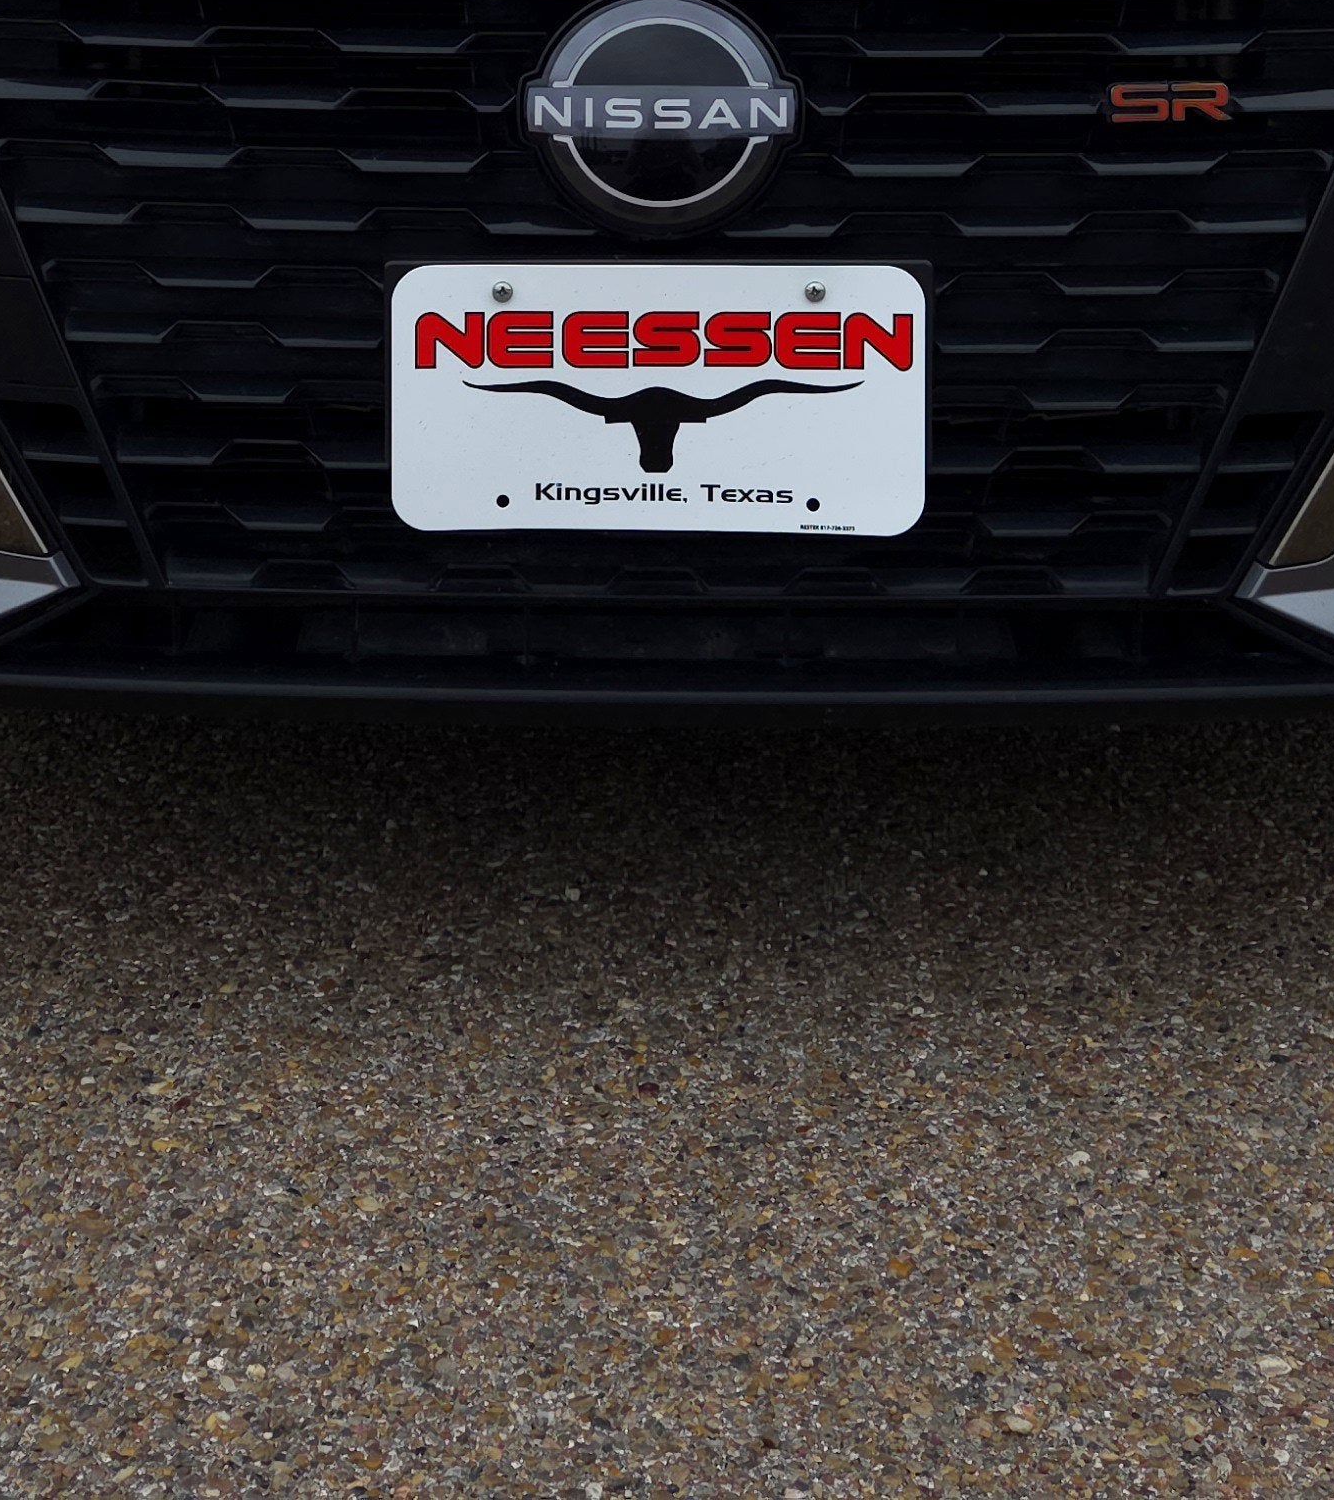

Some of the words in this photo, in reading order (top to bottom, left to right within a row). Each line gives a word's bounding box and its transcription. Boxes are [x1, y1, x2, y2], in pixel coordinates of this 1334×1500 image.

[534, 95, 788, 129] NISSAN
[1110, 82, 1230, 122] SR
[415, 311, 914, 372] NEESSEN
[534, 483, 688, 505] Kingsville,
[700, 484, 794, 504] Texas
